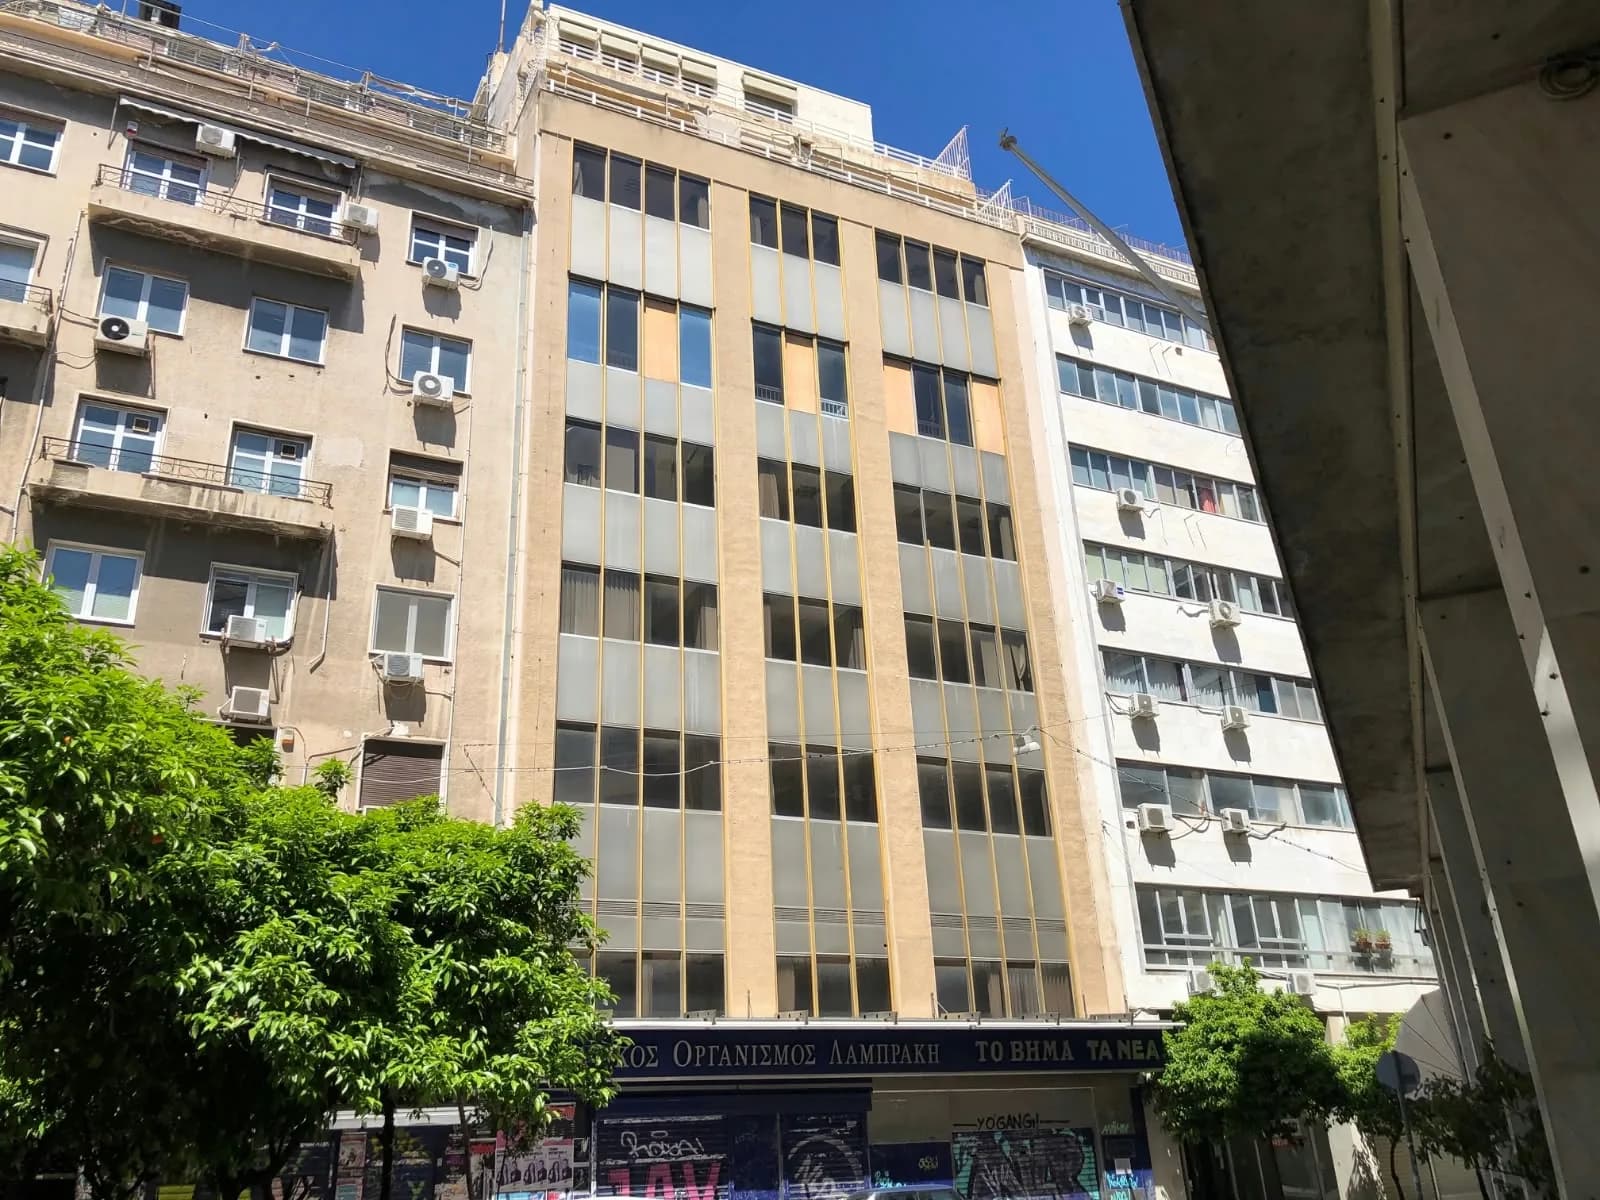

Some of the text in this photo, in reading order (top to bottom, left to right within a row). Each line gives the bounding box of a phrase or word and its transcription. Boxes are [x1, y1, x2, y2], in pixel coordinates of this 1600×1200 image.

[614, 1045, 659, 1068] ΚΟΣ
[975, 1040, 1075, 1062] ΤΟ ΒΗΜΑ
[1087, 1039, 1160, 1061] ΤΑ ΝΕΑ
